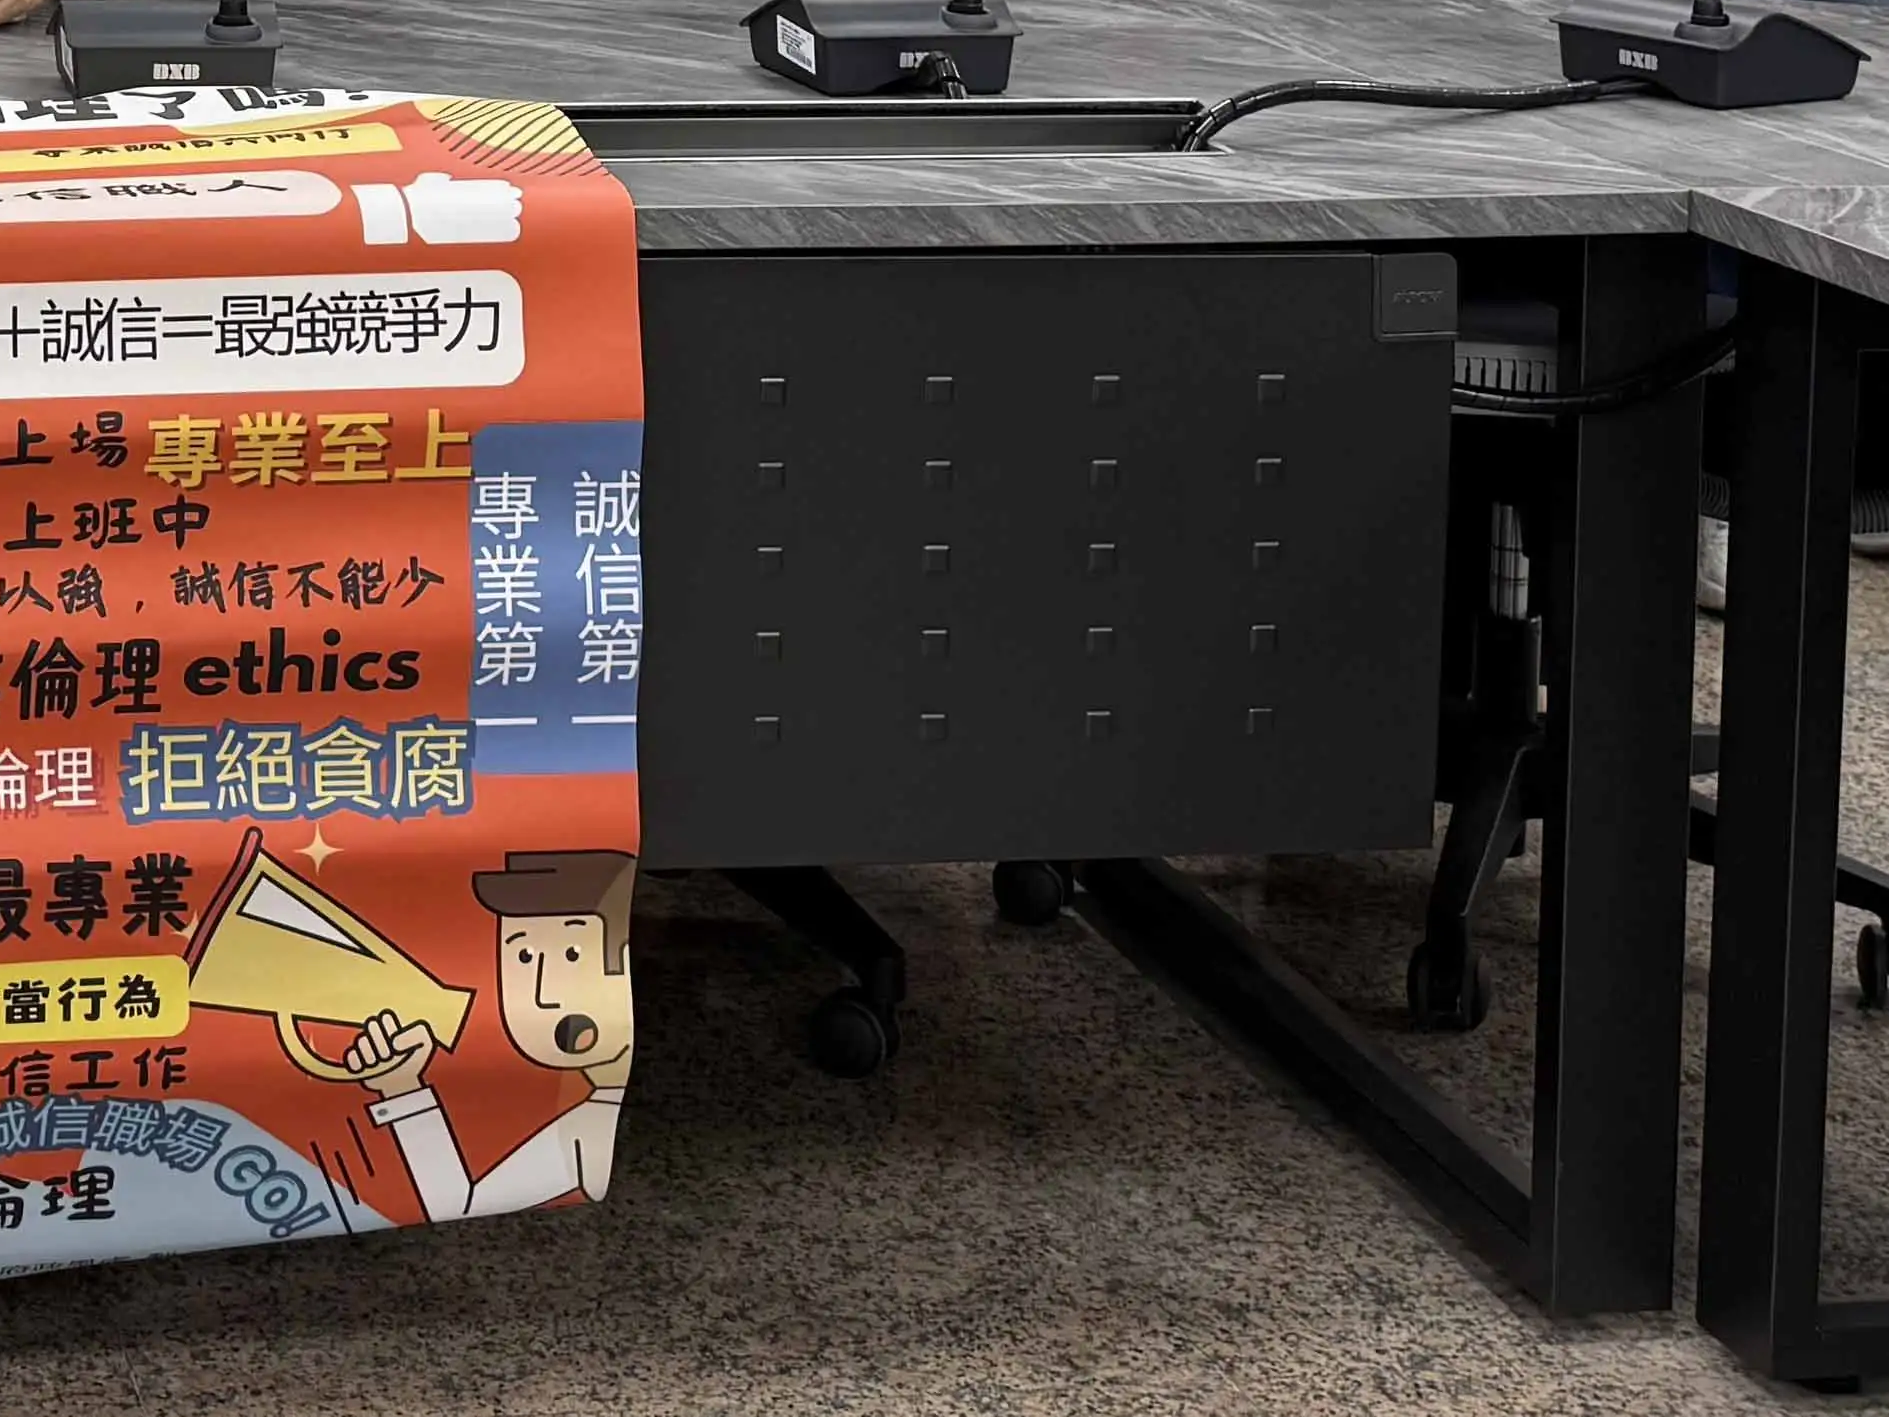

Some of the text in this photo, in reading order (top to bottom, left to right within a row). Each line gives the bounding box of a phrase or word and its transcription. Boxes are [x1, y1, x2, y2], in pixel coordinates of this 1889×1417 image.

[153, 63, 200, 80] BXB
[144, 407, 477, 489] 專業至上
[471, 470, 544, 726] 專業第一
[572, 469, 643, 726] 誠信第一
[182, 629, 421, 697] ethics
[124, 720, 472, 820] 拒絕貪腐
[213, 1144, 330, 1239] GO!
